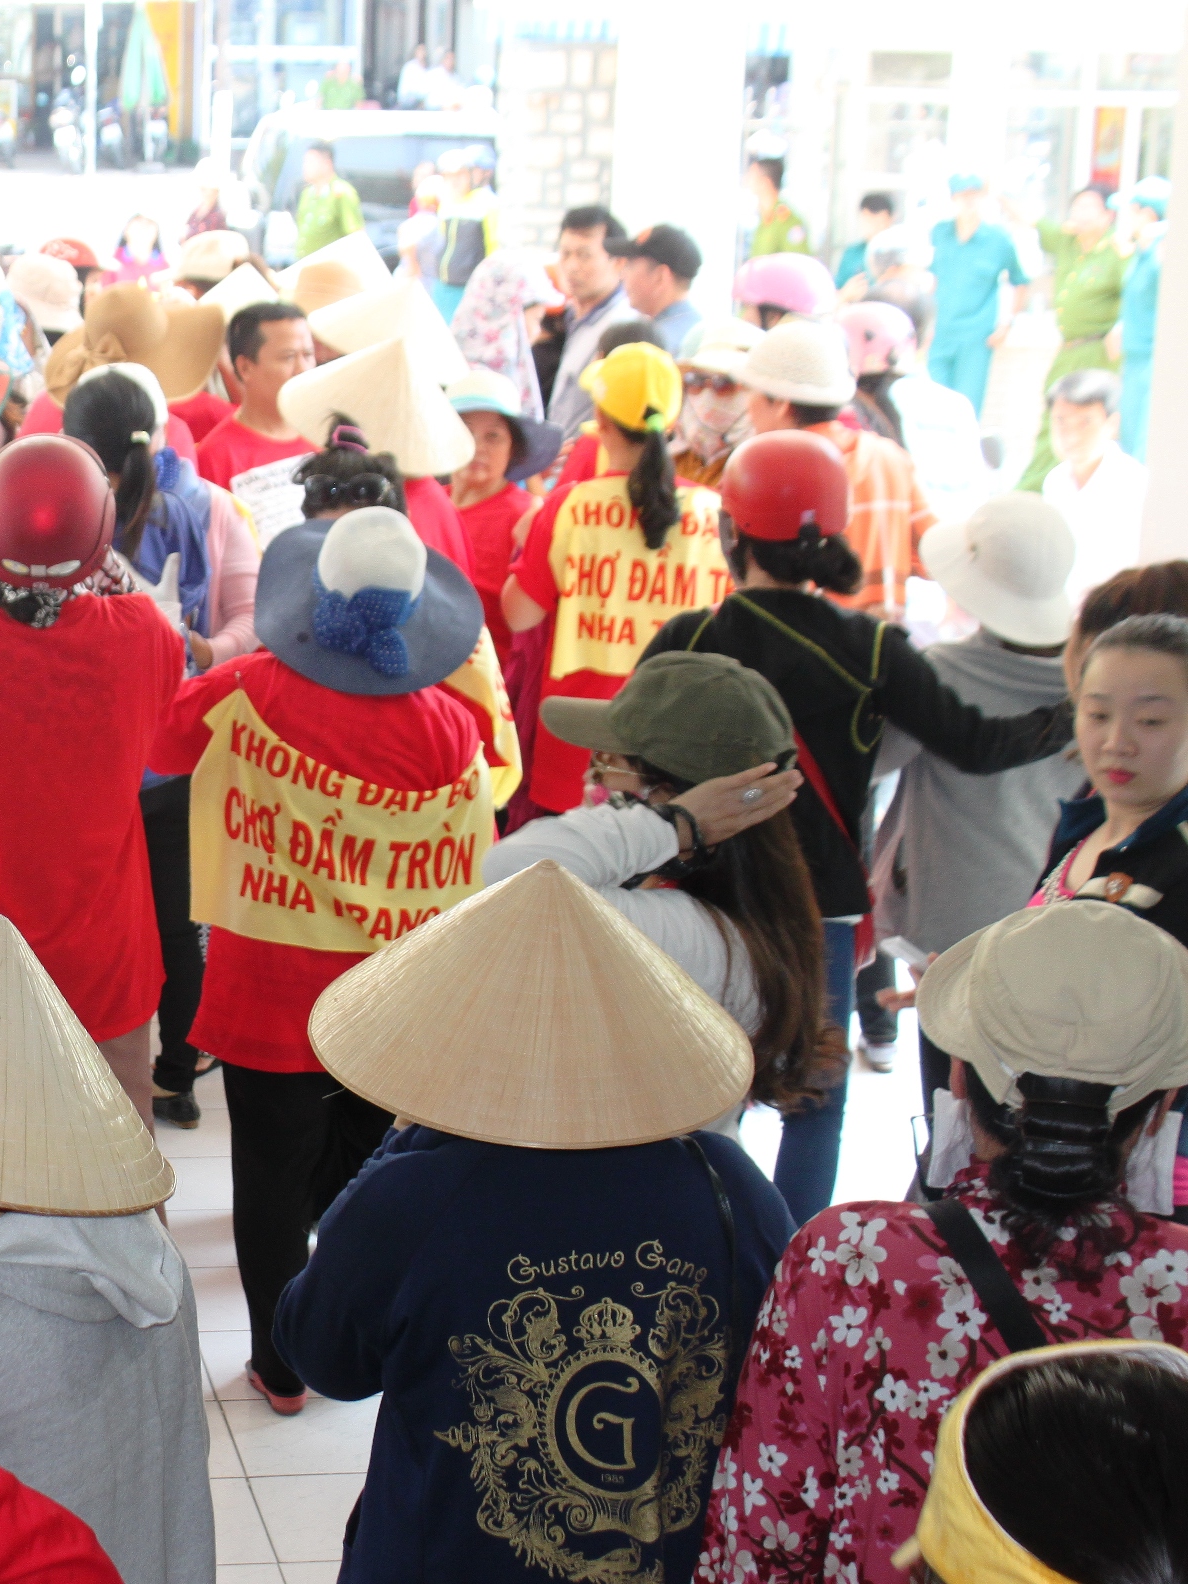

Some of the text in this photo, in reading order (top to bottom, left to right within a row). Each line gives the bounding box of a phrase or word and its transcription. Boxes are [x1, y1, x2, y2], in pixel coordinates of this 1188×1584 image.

[561, 549, 620, 608] CHỢ
[577, 611, 635, 645] NHA
[224, 786, 475, 890] CHỢ ĐẦM TRÒN
[240, 863, 316, 914] NHA
[507, 1250, 625, 1284] Gustavo
[566, 1376, 639, 1470] G
